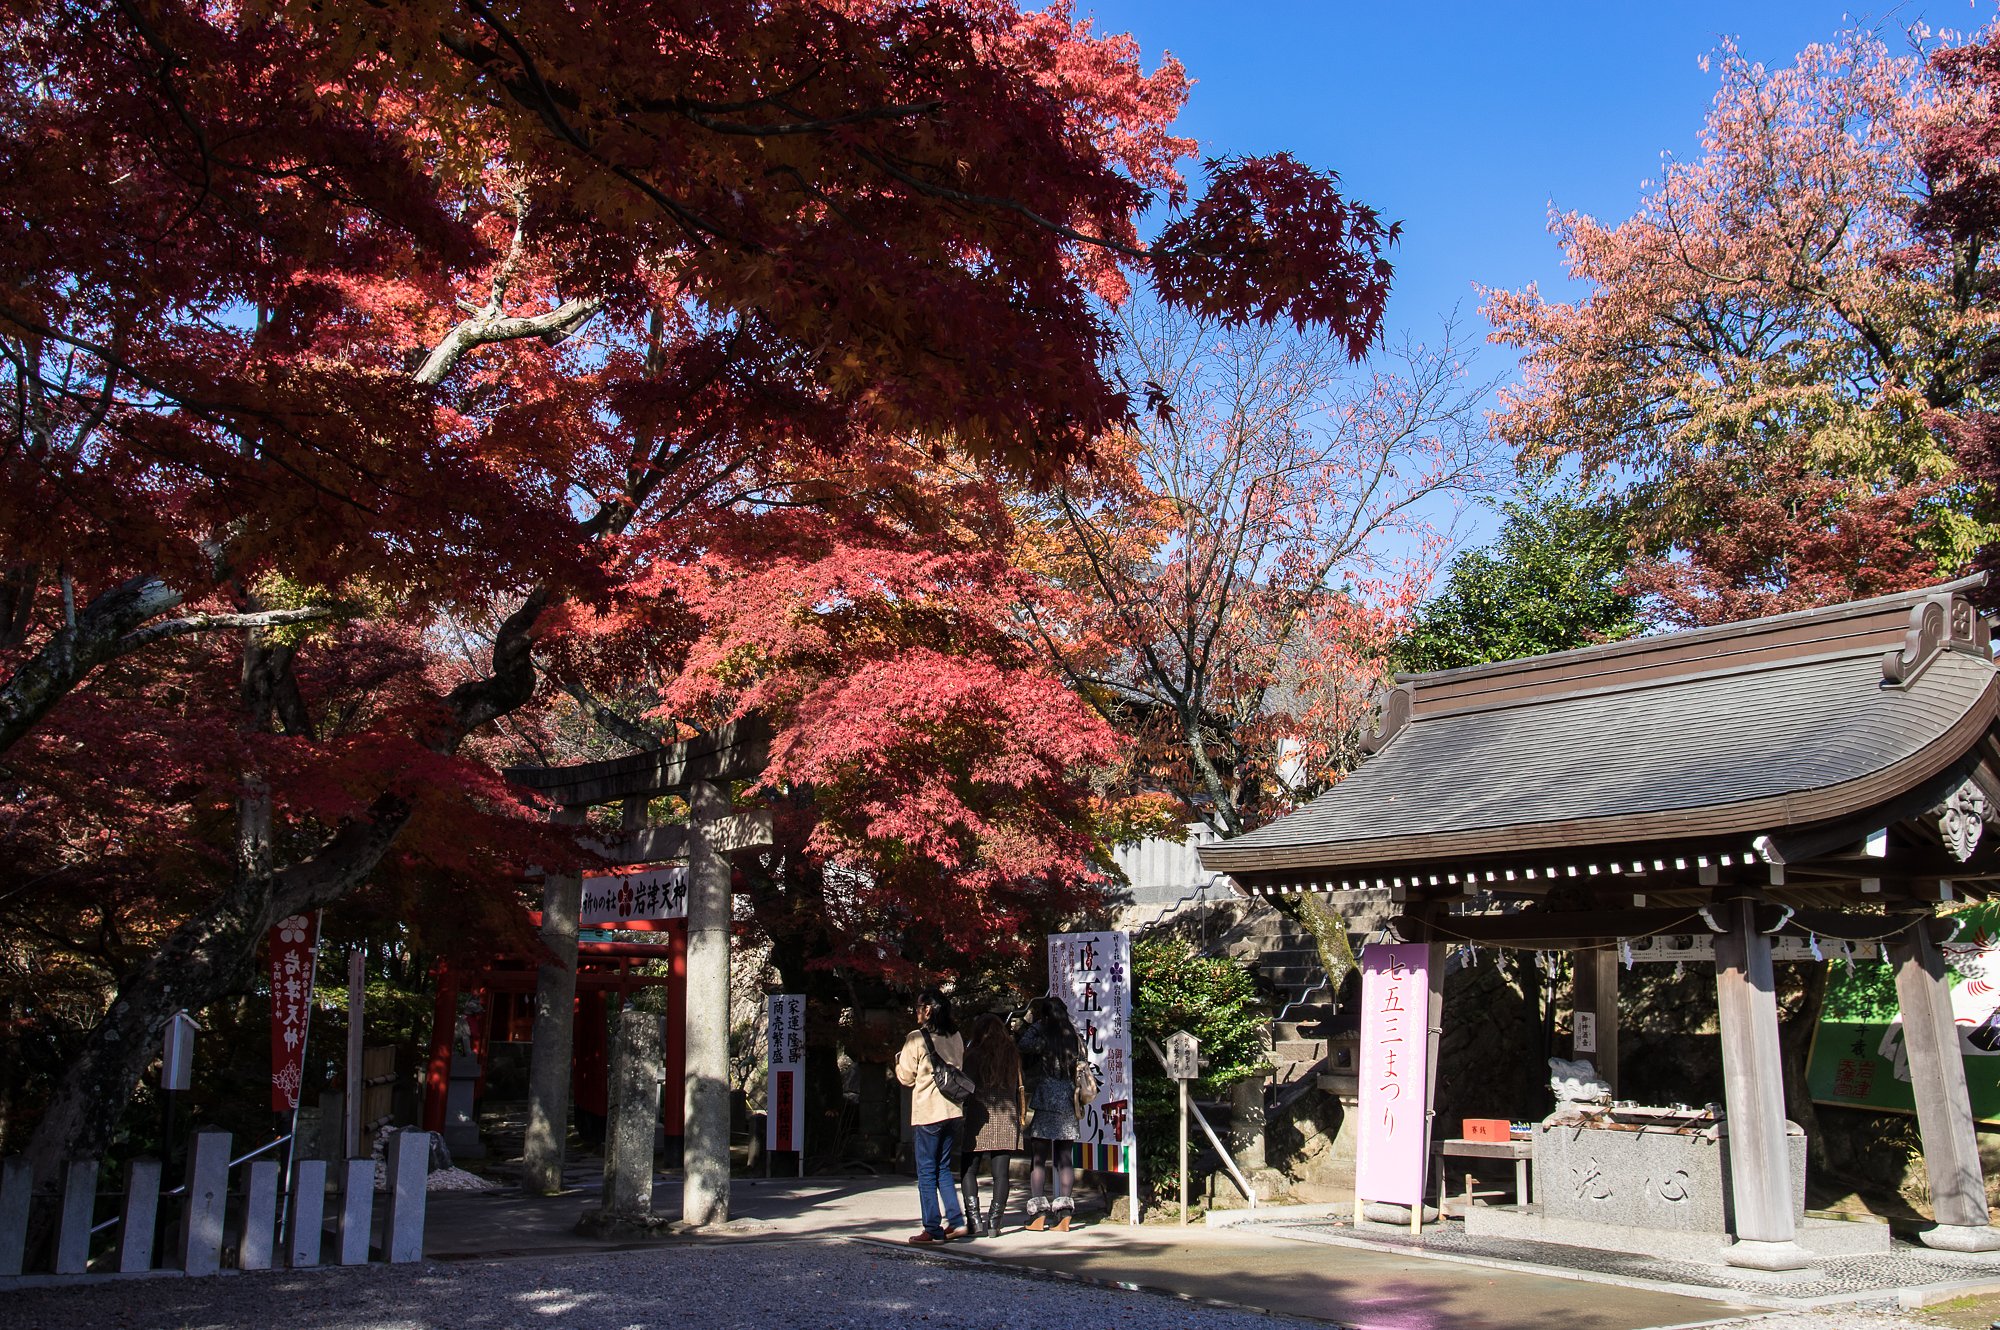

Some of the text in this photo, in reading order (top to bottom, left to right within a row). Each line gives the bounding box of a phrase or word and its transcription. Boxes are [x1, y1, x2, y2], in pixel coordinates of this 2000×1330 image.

[582, 875, 687, 916] 祈りの社 岩津天神
[283, 949, 301, 1053] 岩津天神
[771, 998, 785, 1065] 商売繁盛
[787, 998, 801, 1065] 家運隆昌
[1113, 984, 1122, 1040] 岩津天満宮
[1107, 1047, 1115, 1102] 鳥居くぐり
[1114, 1048, 1123, 1084] 御神前
[1379, 952, 1406, 1143] 七五三まつり
